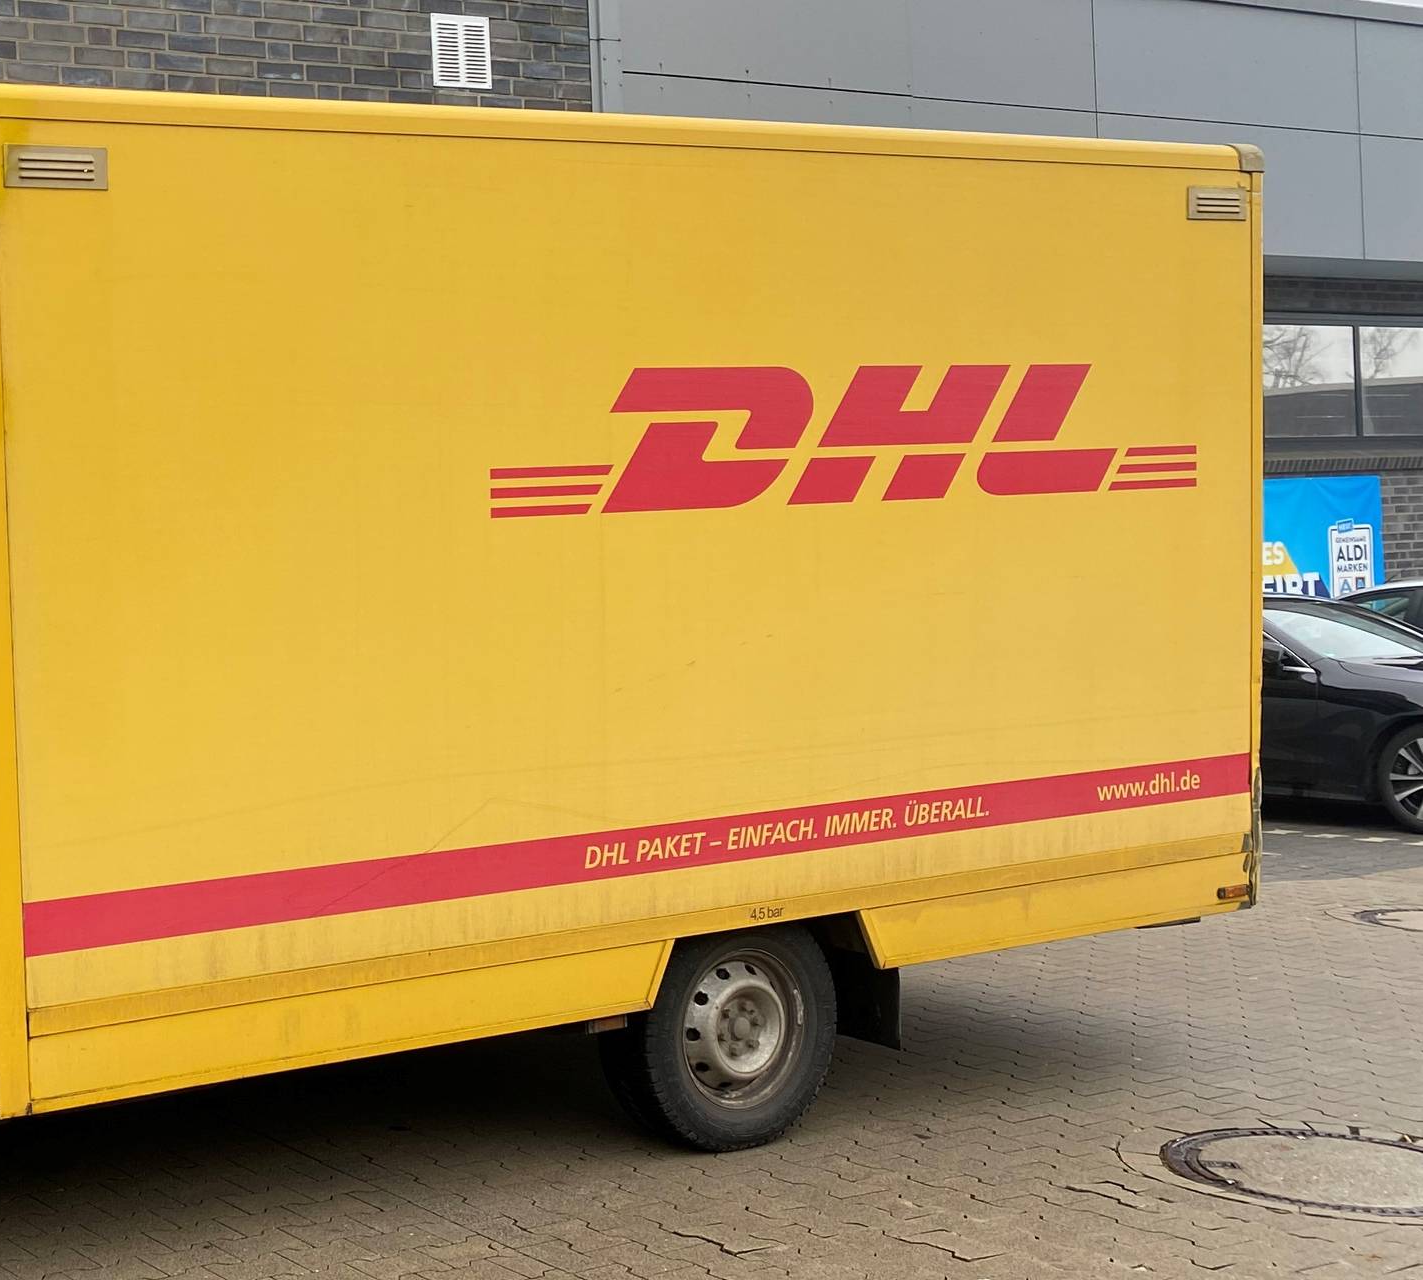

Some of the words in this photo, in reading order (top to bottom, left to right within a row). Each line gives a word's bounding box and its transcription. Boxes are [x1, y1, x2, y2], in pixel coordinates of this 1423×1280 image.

[601, 364, 1120, 513] DHL
[1337, 544, 1368, 562] ALDI
[1337, 562, 1368, 573] MARKEN
[1096, 770, 1201, 802] www.dhl.de
[584, 844, 630, 869] DHL
[636, 831, 707, 862] PAKET
[727, 818, 818, 852] EINFACH.
[824, 808, 897, 838] IMMER.
[904, 796, 990, 827] ÜBERALL.
[767, 905, 785, 918] bar
